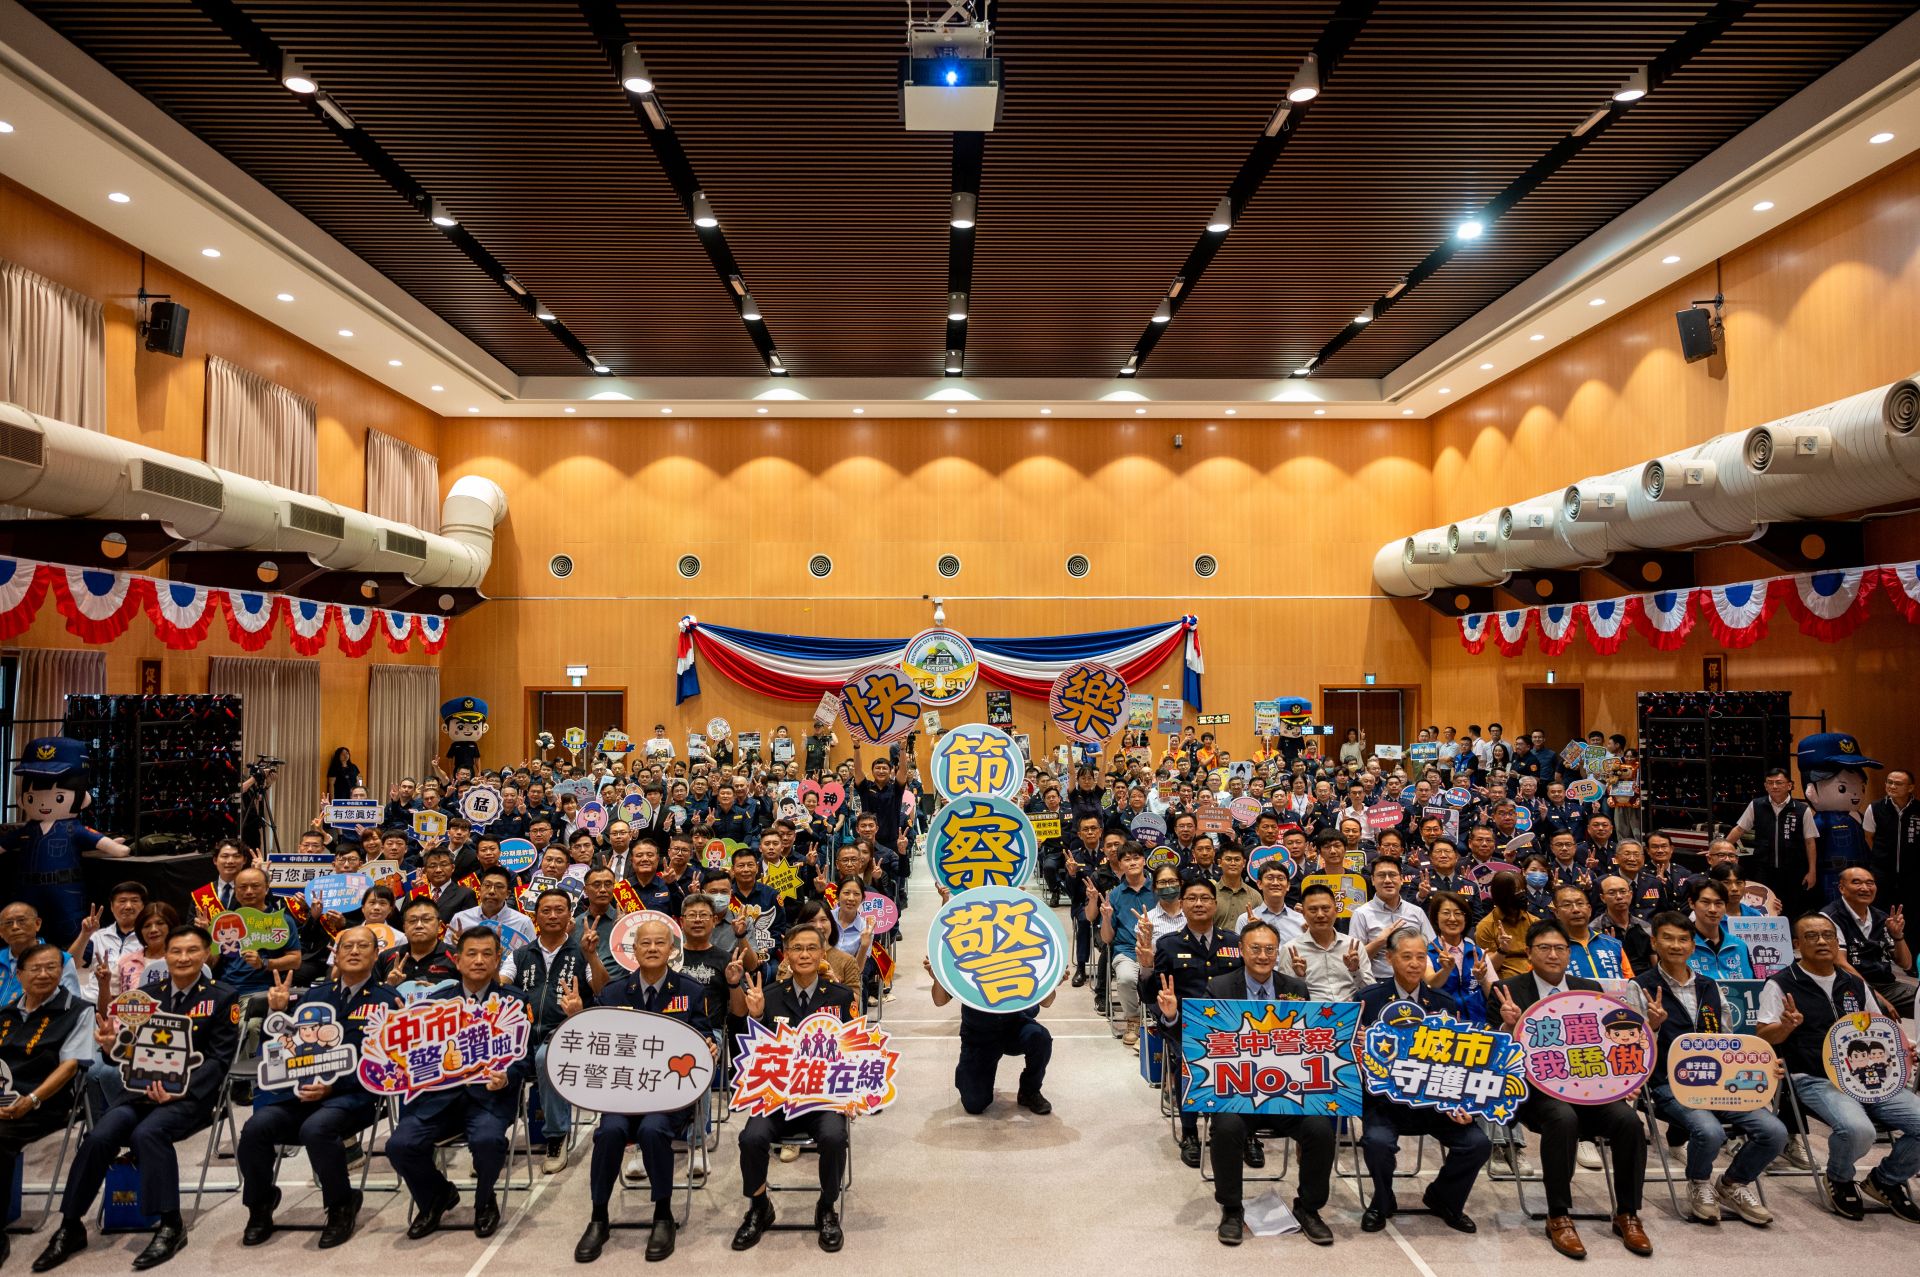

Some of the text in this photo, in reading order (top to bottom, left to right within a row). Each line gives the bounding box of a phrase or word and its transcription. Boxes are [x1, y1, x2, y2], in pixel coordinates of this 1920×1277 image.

[842, 672, 922, 742] 快
[1053, 666, 1126, 739] 樂
[944, 732, 1011, 796] 節
[473, 796, 489, 812] 猛
[823, 791, 838, 806] 神
[1575, 784, 1593, 792] 165
[938, 801, 1027, 889] 察
[862, 898, 884, 912] 保護
[938, 898, 1050, 1008] 警
[1756, 956, 1777, 964] 更美好
[148, 1018, 181, 1028] POLICE
[387, 1005, 461, 1054] 中市
[1525, 1012, 1603, 1049] 波麗
[560, 1029, 665, 1060] 幸福臺中
[1206, 1027, 1337, 1058] 臺中警察
[1408, 1025, 1494, 1067] 城市
[1680, 1039, 1741, 1051] 無號誌路口
[556, 1061, 662, 1093] 有警真好
[747, 1043, 885, 1096] 英雄在線
[1214, 1055, 1338, 1098] No.1
[1530, 1045, 1648, 1081] 我驕傲
[1390, 1059, 1504, 1105] 守護中
